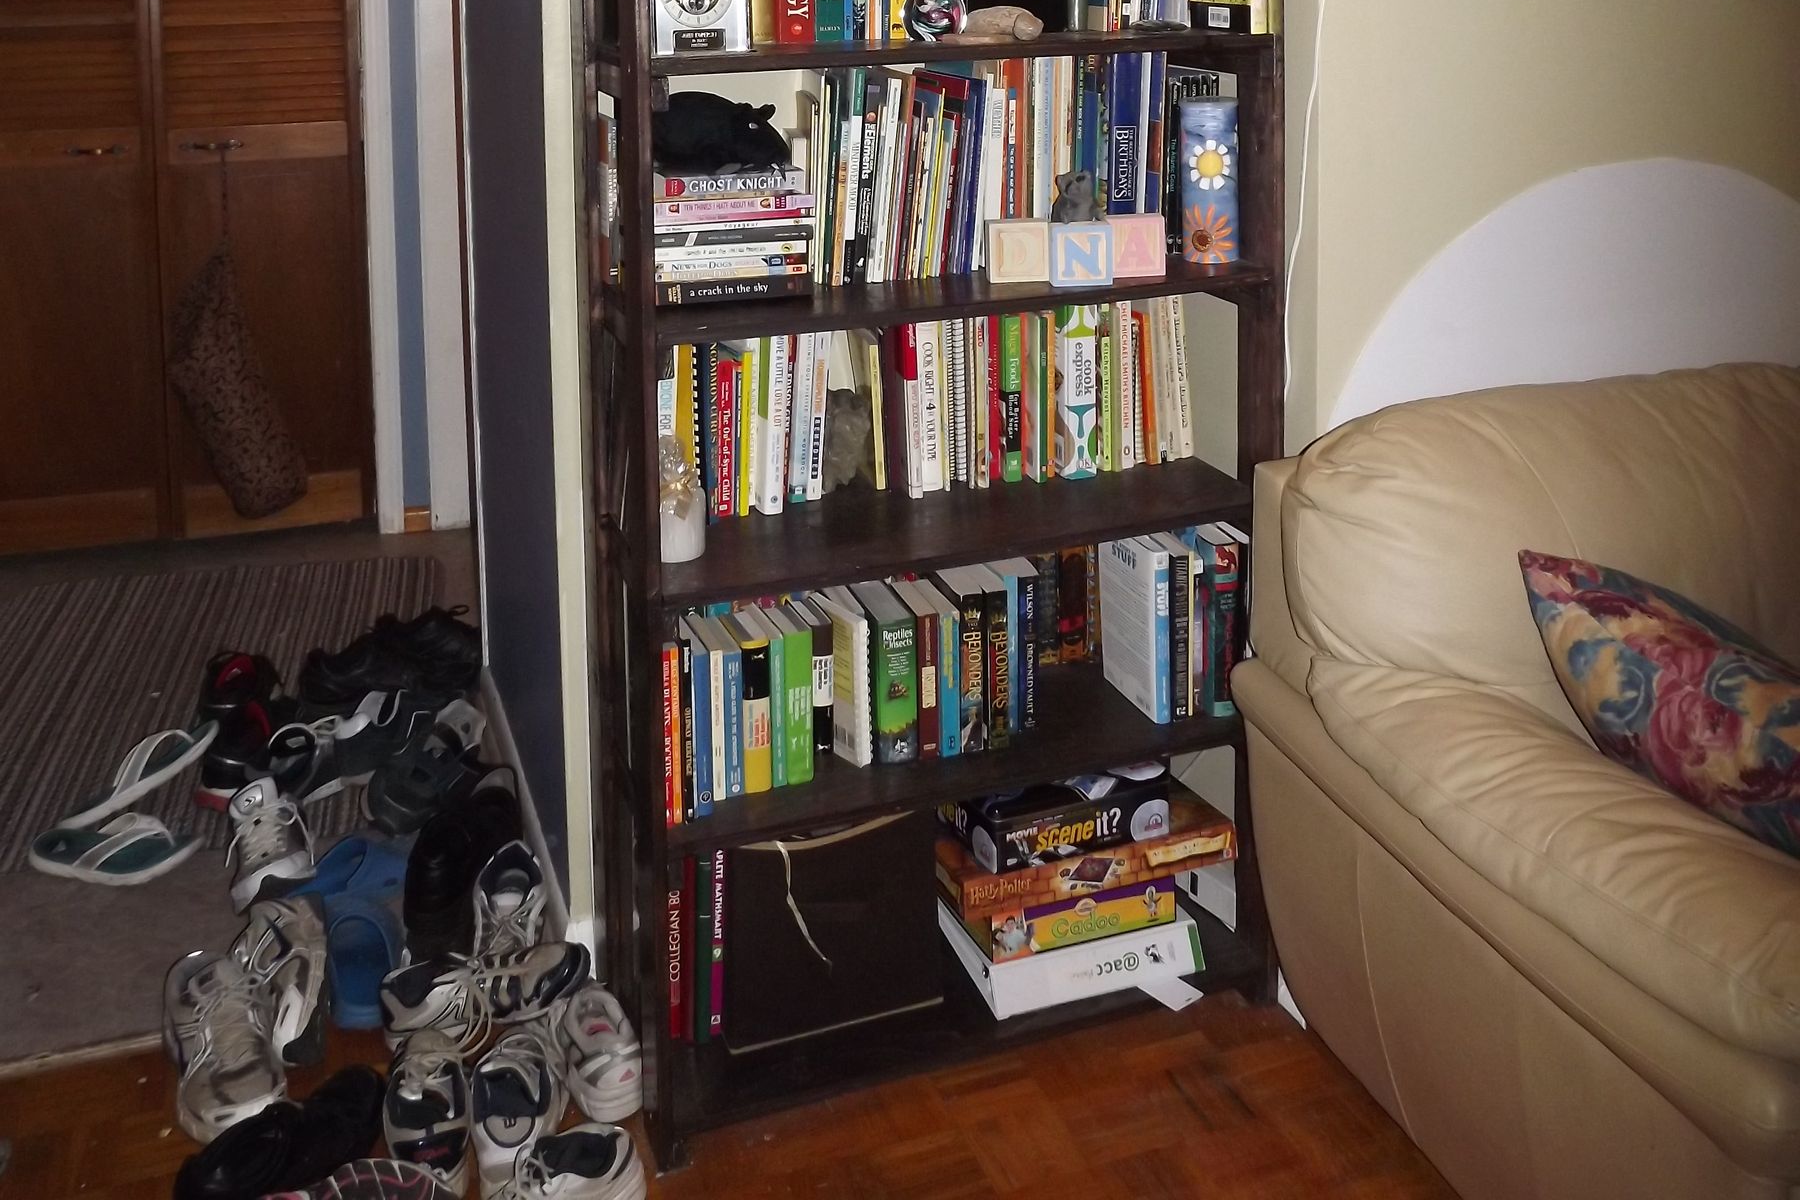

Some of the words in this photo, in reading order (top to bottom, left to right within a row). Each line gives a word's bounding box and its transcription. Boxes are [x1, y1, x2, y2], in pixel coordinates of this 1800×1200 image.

[689, 178, 733, 193] GHOST
[736, 176, 783, 191] KNIGHT
[1115, 129, 1129, 198] BIRTHDAYS
[697, 287, 722, 297] crack
[724, 286, 734, 294] in
[737, 284, 751, 293] the
[753, 282, 769, 294] sky
[709, 342, 718, 403] NCOMMON
[1072, 342, 1084, 397] express
[1084, 359, 1094, 395] cook
[660, 381, 673, 410] EDICINE
[722, 408, 731, 425] The
[721, 479, 731, 501] Child
[962, 631, 983, 701] BEYONDERS
[990, 631, 1008, 709] BEYONDERS
[669, 910, 680, 982] COLLEGIAN
